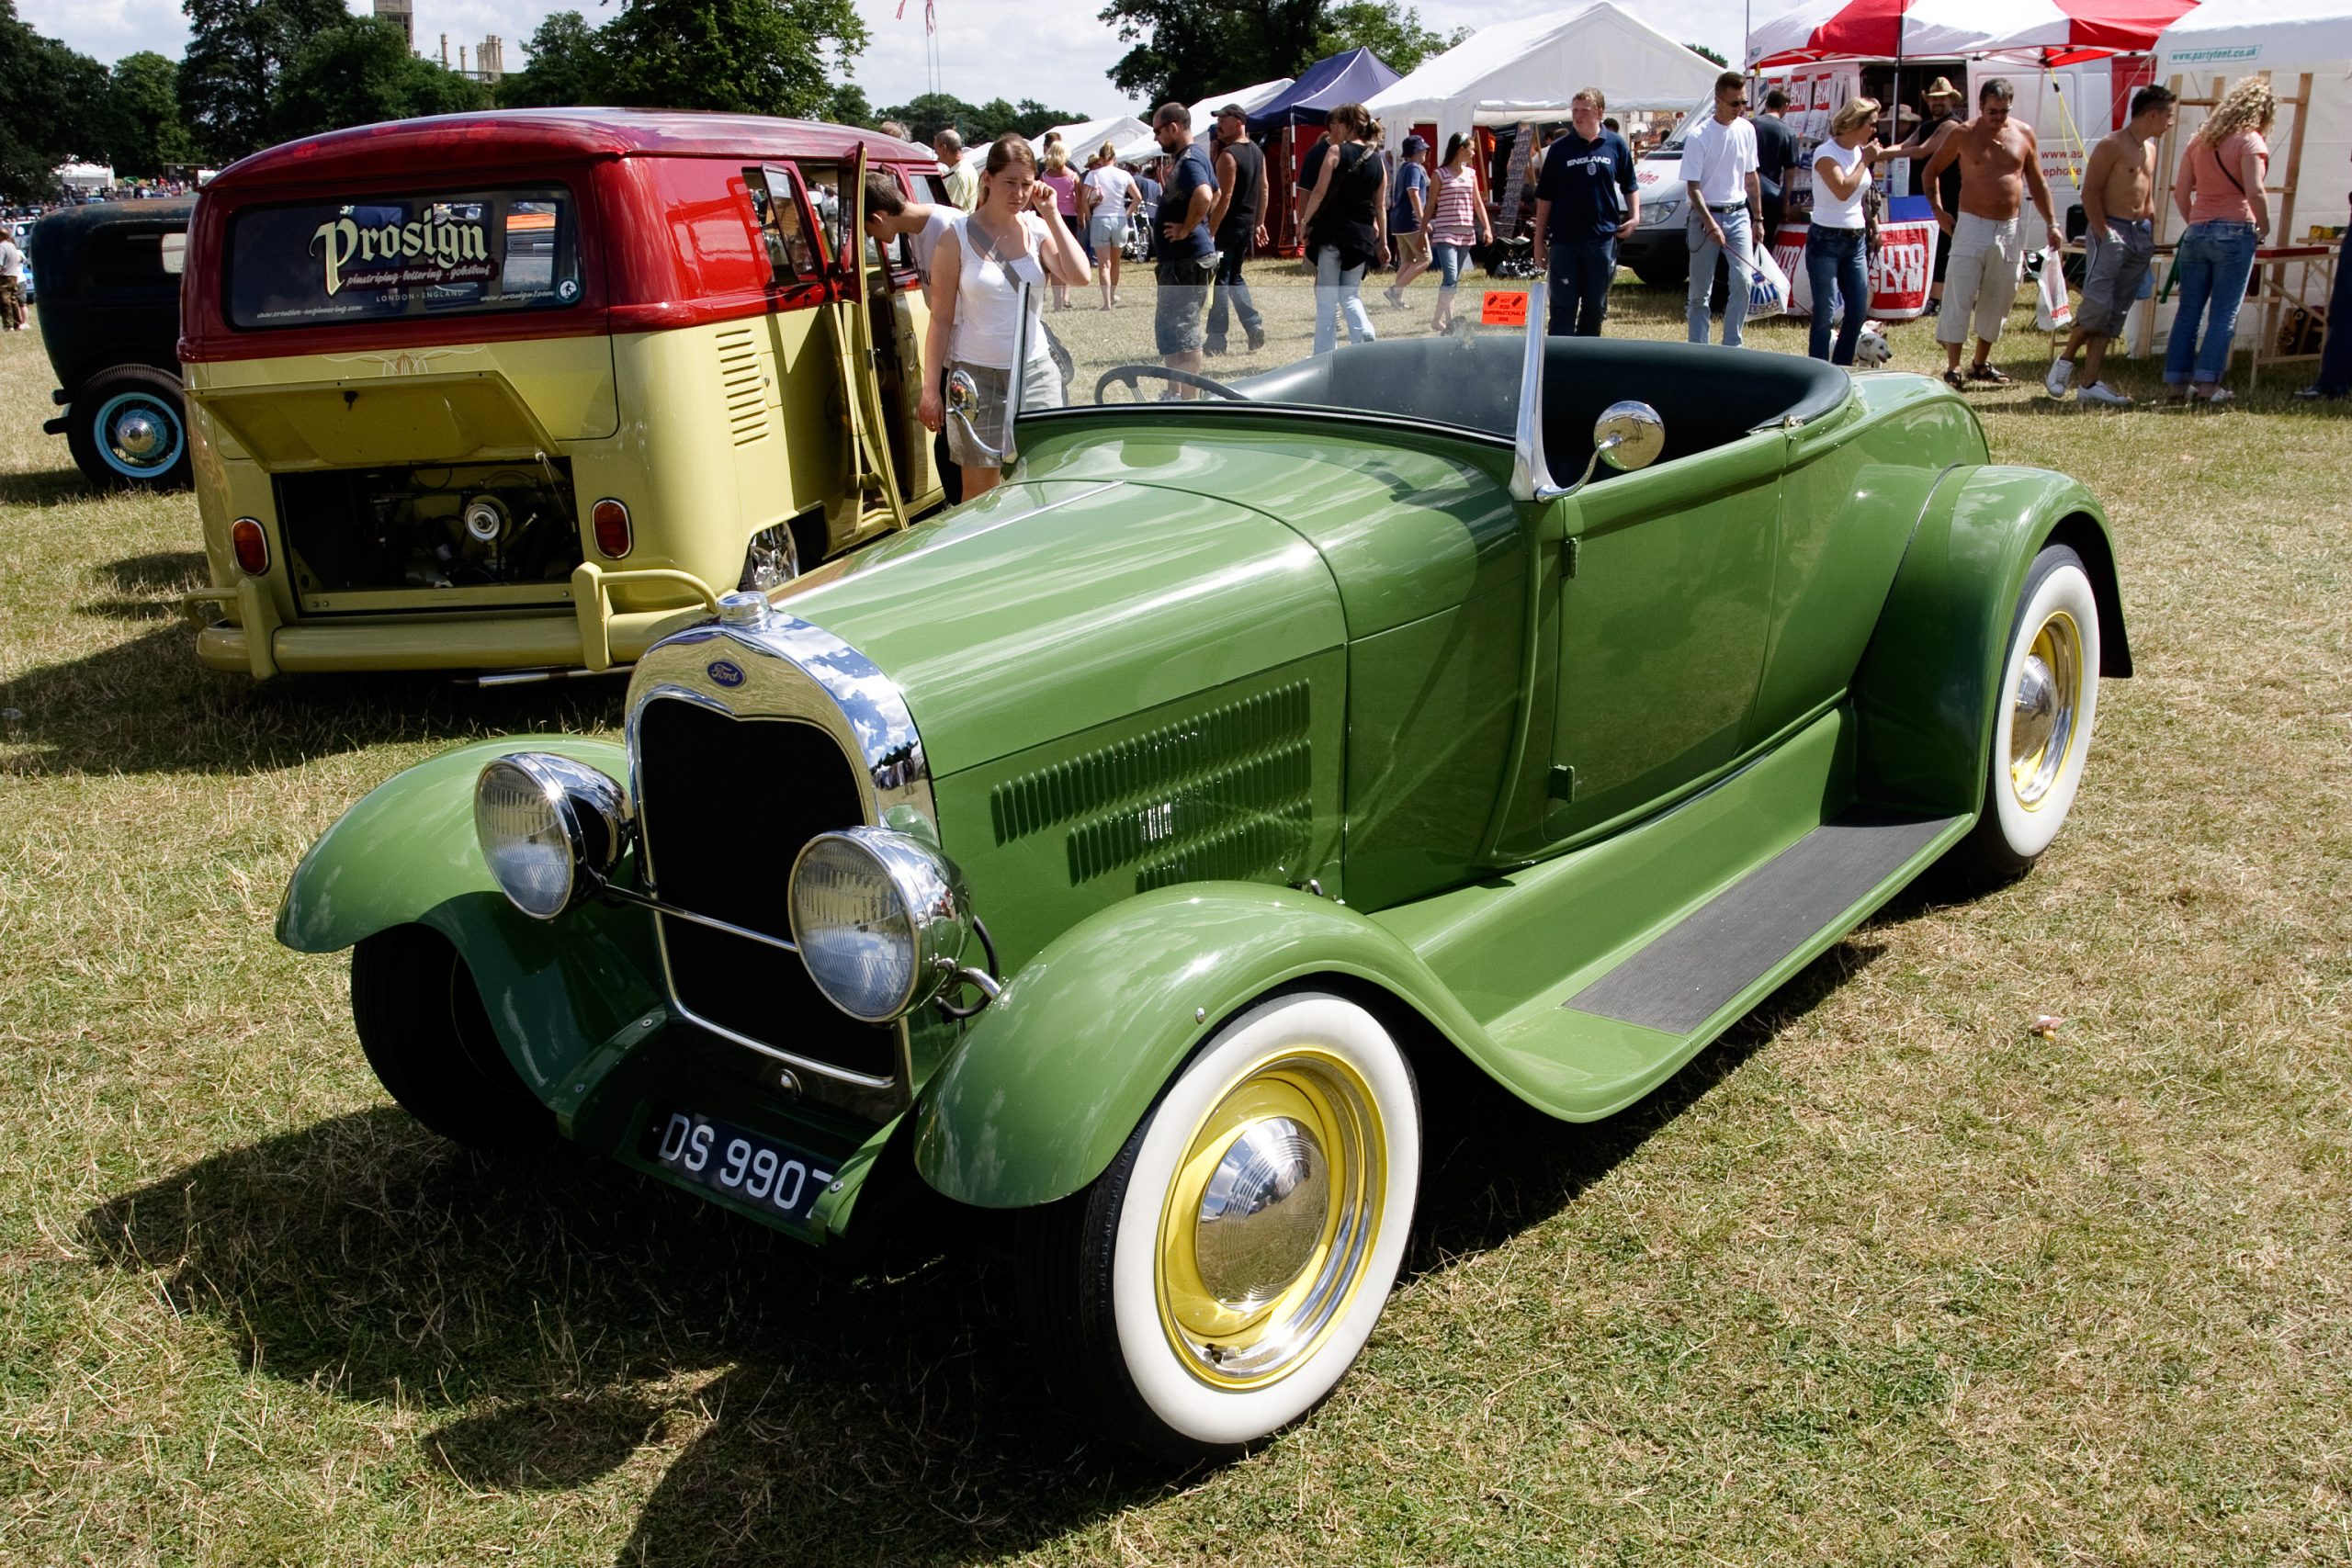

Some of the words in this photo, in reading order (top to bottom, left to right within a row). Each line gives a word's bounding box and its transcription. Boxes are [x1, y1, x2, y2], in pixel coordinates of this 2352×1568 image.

[1566, 155, 1611, 167] ENGLAND
[309, 208, 488, 296] Prosign
[377, 293, 414, 302] LONDON
[422, 290, 463, 299] ENGLAND
[711, 663, 739, 682] Ford
[659, 1112, 715, 1171] DS
